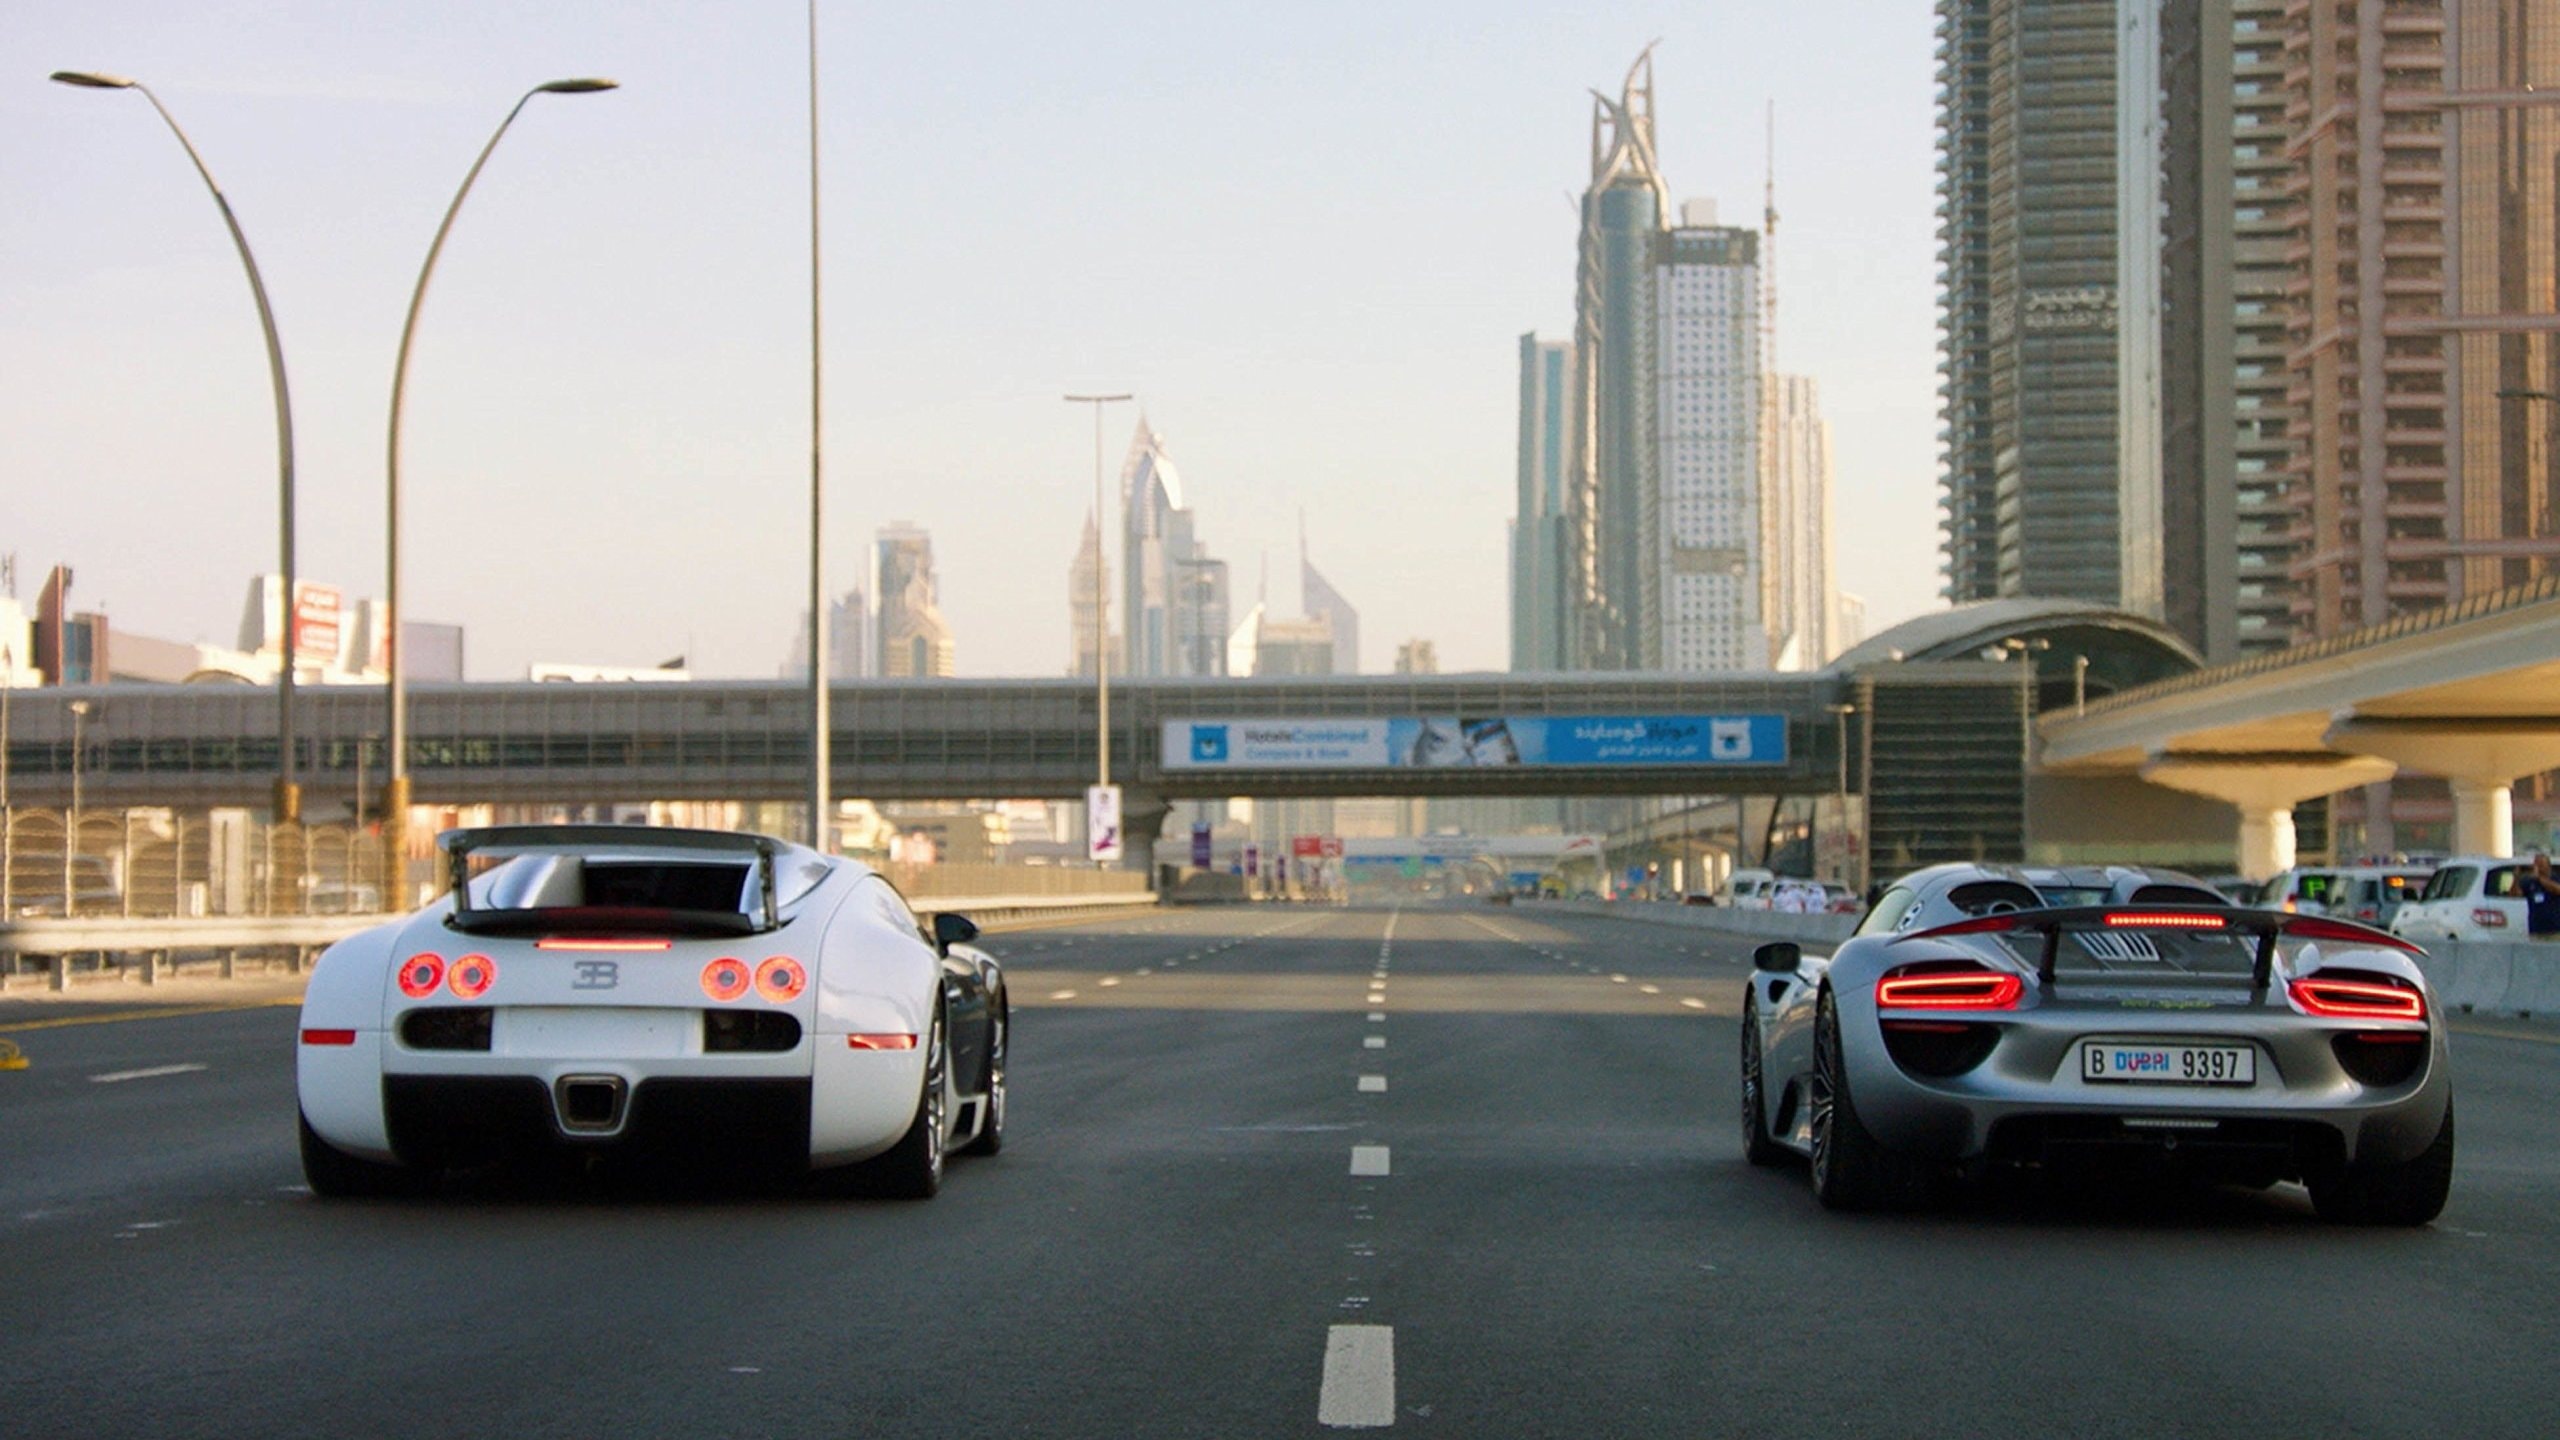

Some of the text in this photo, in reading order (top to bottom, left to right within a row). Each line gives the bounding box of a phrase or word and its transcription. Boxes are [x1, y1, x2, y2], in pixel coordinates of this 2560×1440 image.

[2091, 1050, 2238, 1079] B DUBAI 9397
